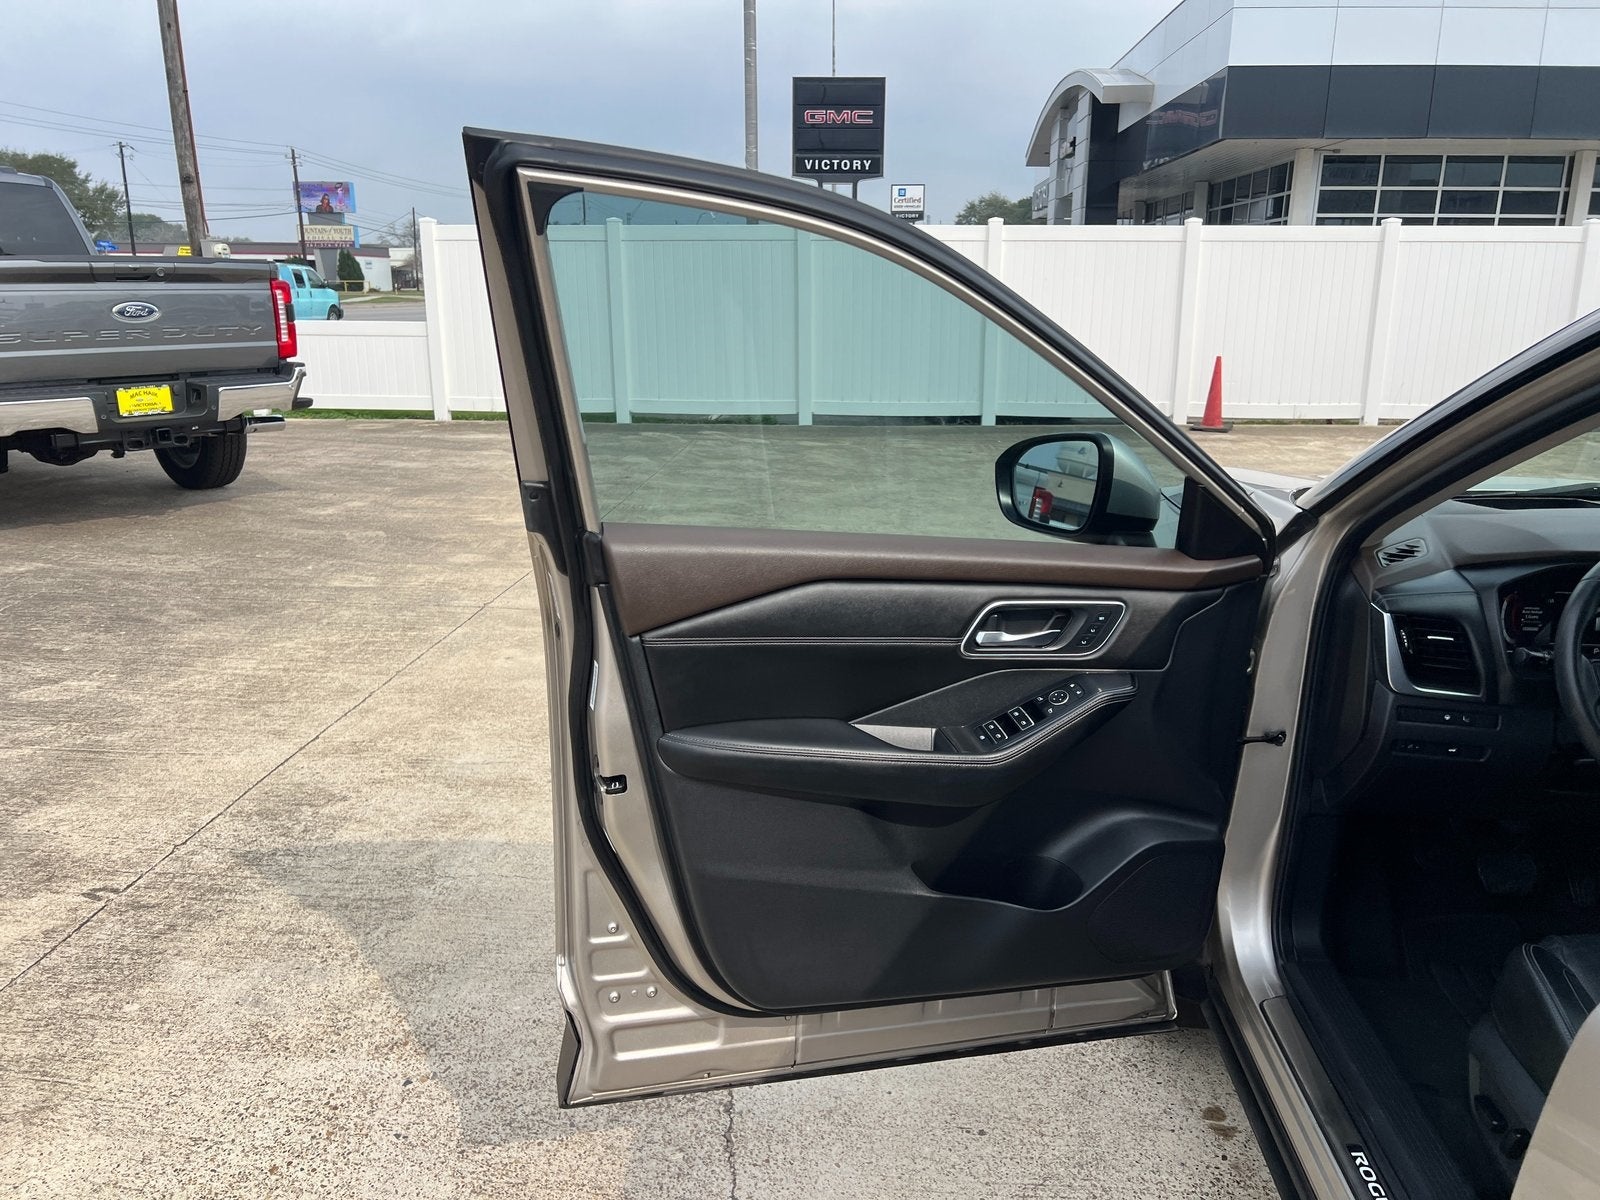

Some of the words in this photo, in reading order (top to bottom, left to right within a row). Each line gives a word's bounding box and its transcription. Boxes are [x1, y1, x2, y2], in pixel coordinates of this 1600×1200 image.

[804, 109, 874, 124] GMC
[804, 159, 872, 170] VICTORY
[125, 305, 149, 317] Ford
[0, 328, 151, 344] SUPER
[162, 325, 263, 339] DUTY
[1351, 1151, 1388, 1200] ROG
